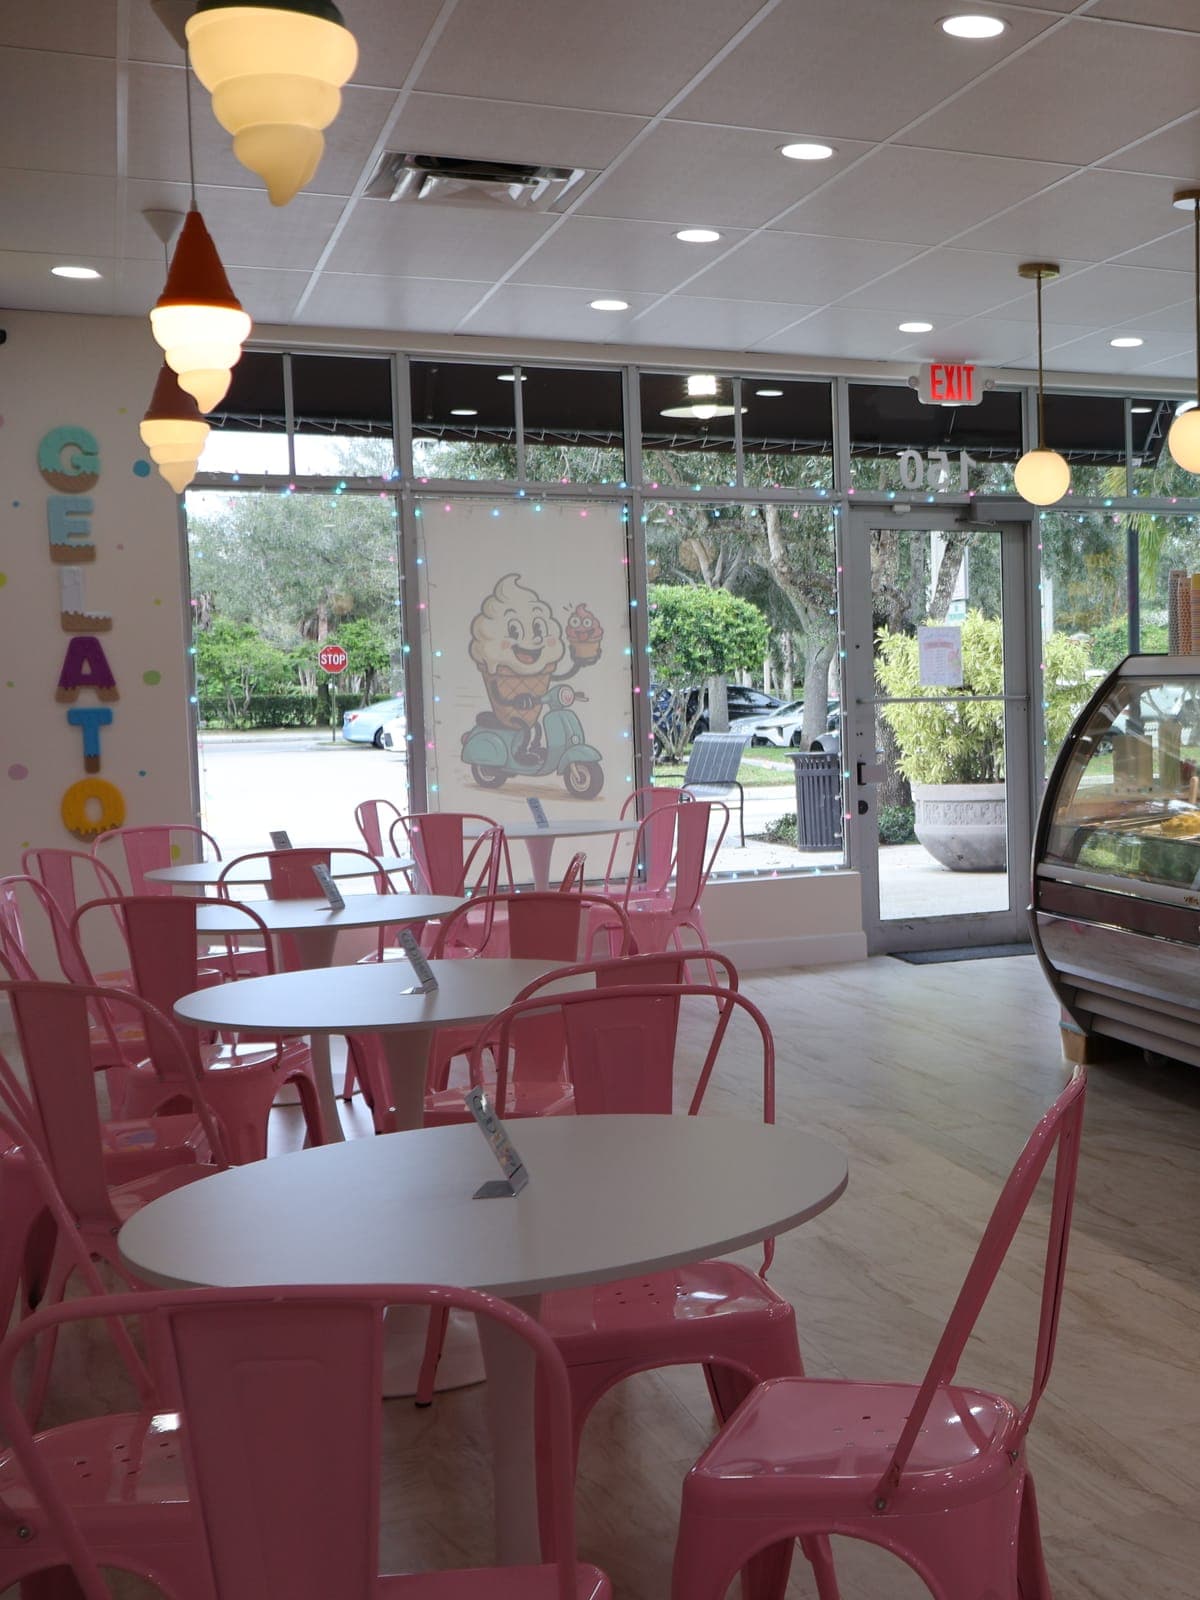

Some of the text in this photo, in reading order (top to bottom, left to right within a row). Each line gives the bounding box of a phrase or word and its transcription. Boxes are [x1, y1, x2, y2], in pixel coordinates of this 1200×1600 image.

[930, 363, 975, 401] EXIT
[37, 425, 126, 844] GELATO
[321, 654, 346, 665] STOP
